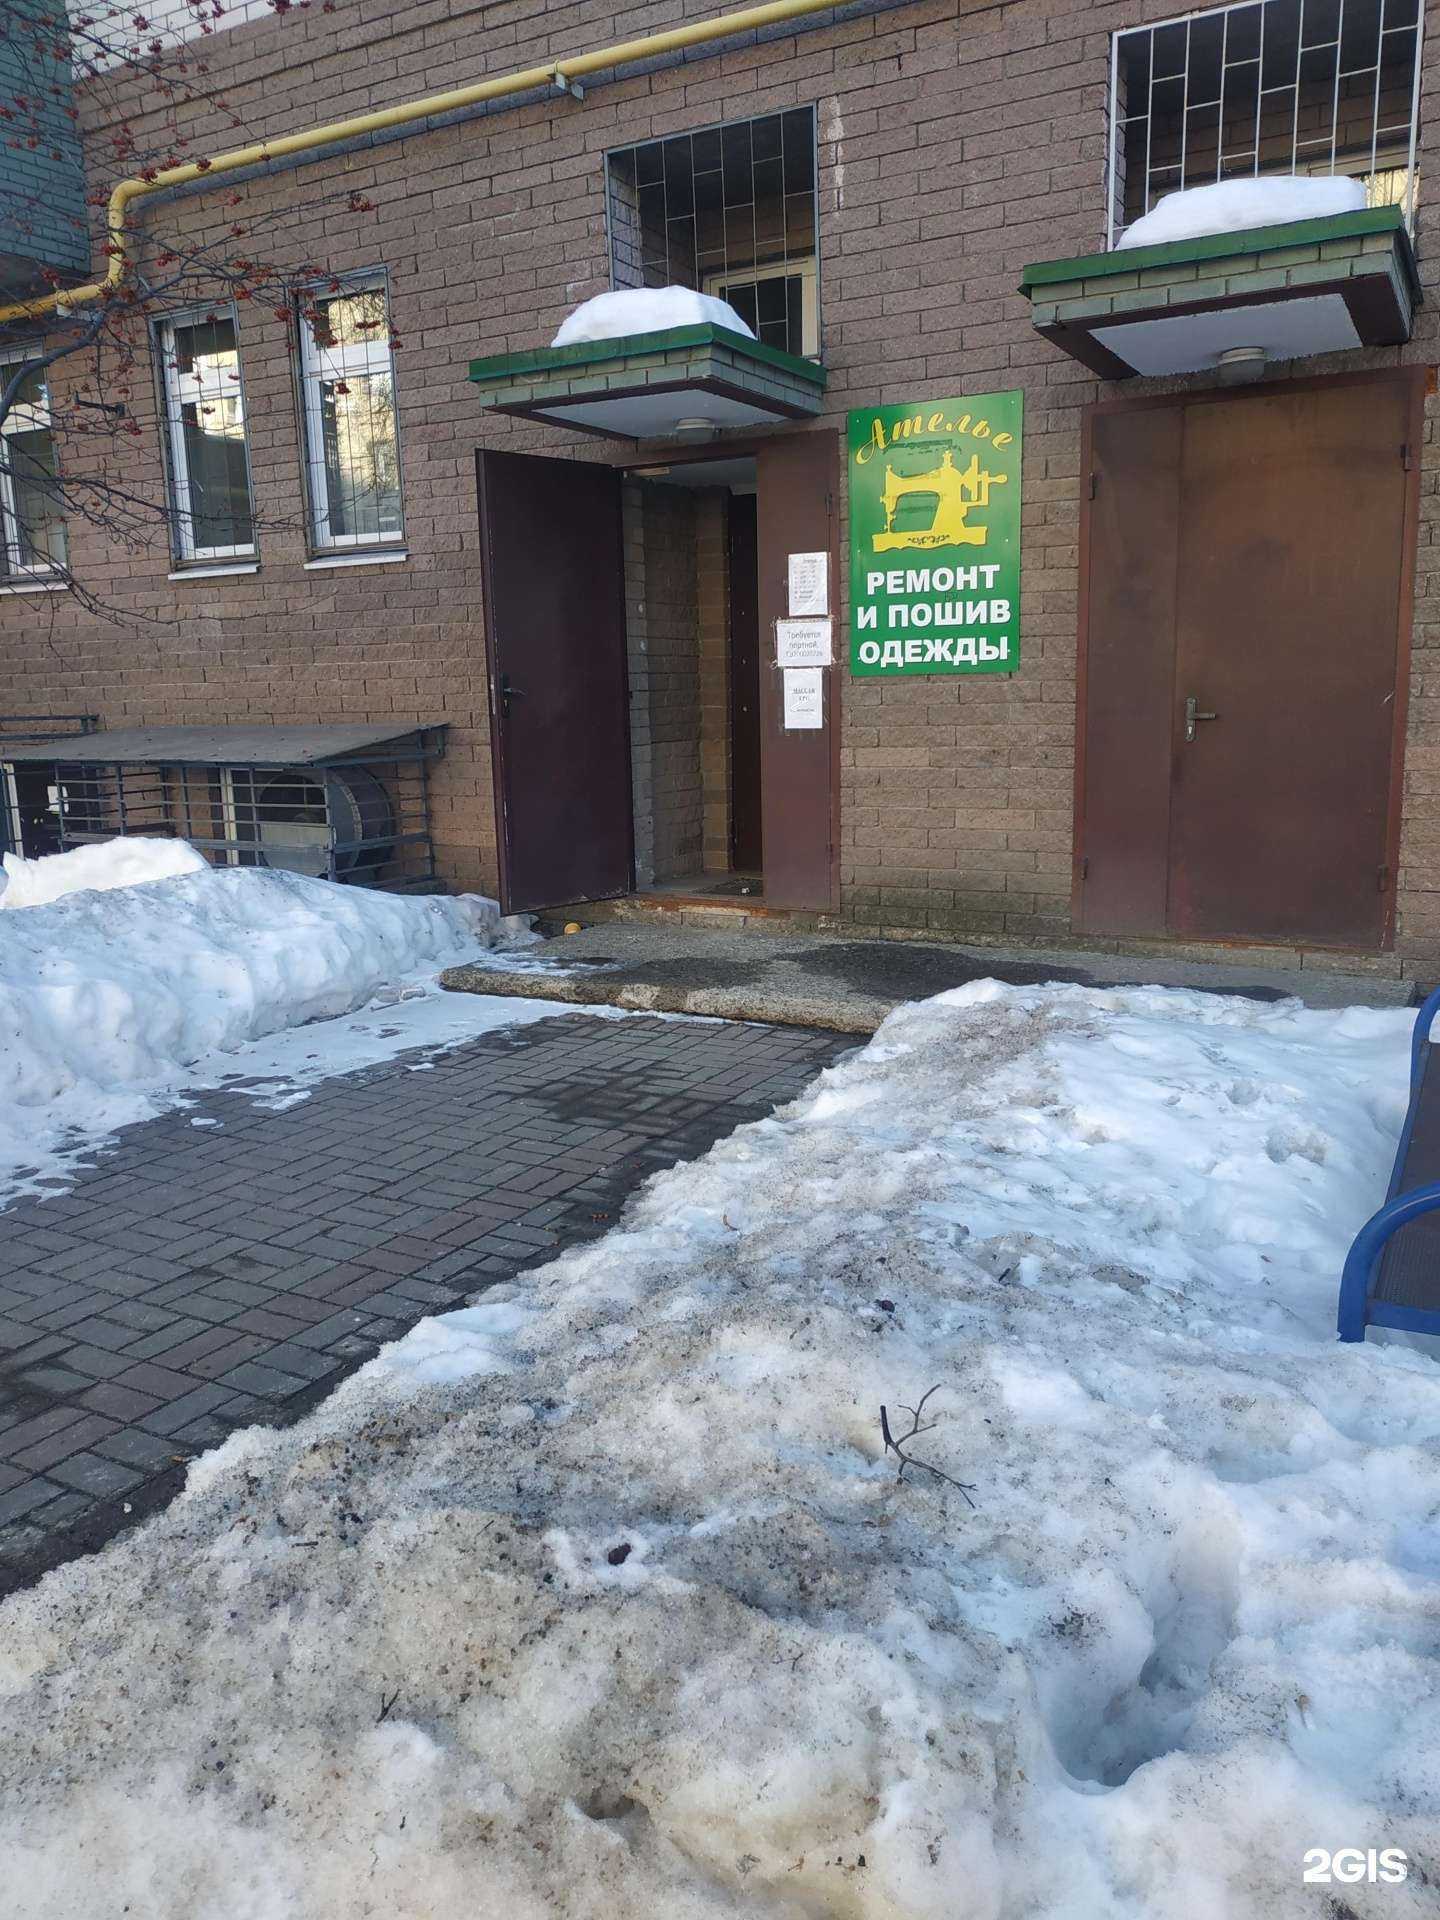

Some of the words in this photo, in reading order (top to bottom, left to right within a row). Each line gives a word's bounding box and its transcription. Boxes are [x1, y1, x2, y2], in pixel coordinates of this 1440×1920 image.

[856, 411, 1013, 465] Ателье
[867, 564, 1000, 595] РЕМОНТ
[857, 606, 877, 629] И
[888, 599, 1011, 628] ПОШИВ
[859, 636, 1008, 668] ОДЕЖДЫ
